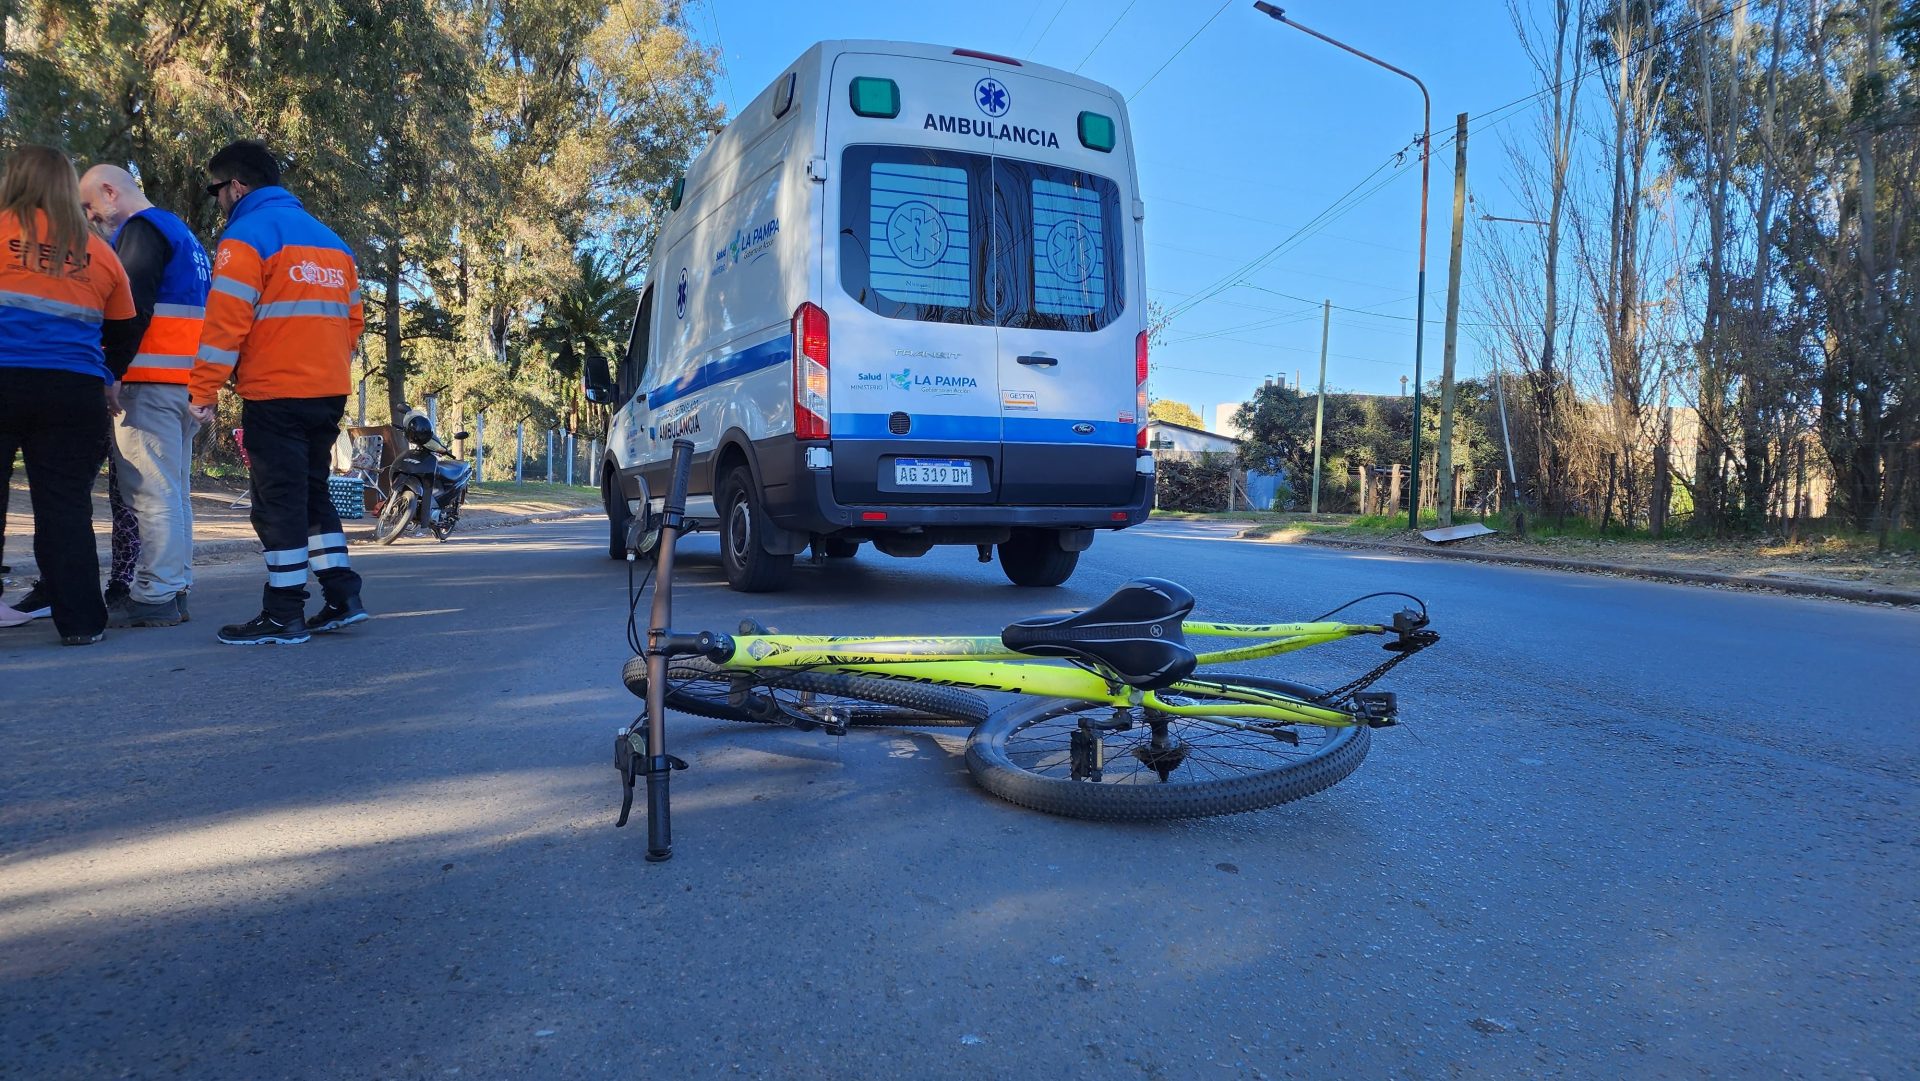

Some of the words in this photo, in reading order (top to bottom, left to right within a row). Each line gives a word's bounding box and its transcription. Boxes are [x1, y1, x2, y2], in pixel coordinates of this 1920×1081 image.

[923, 113, 1060, 149] AMBULANCIA
[741, 232, 751, 252] LA
[752, 217, 780, 246] PAMPA
[858, 372, 882, 381] Salud
[914, 375, 932, 386] LA
[935, 376, 978, 388] PAMPA
[1009, 392, 1035, 400] GESTYA
[659, 413, 701, 442] AMBULANCIA
[900, 467, 917, 482] AG
[921, 467, 947, 482] 319
[952, 468, 969, 483] DM
